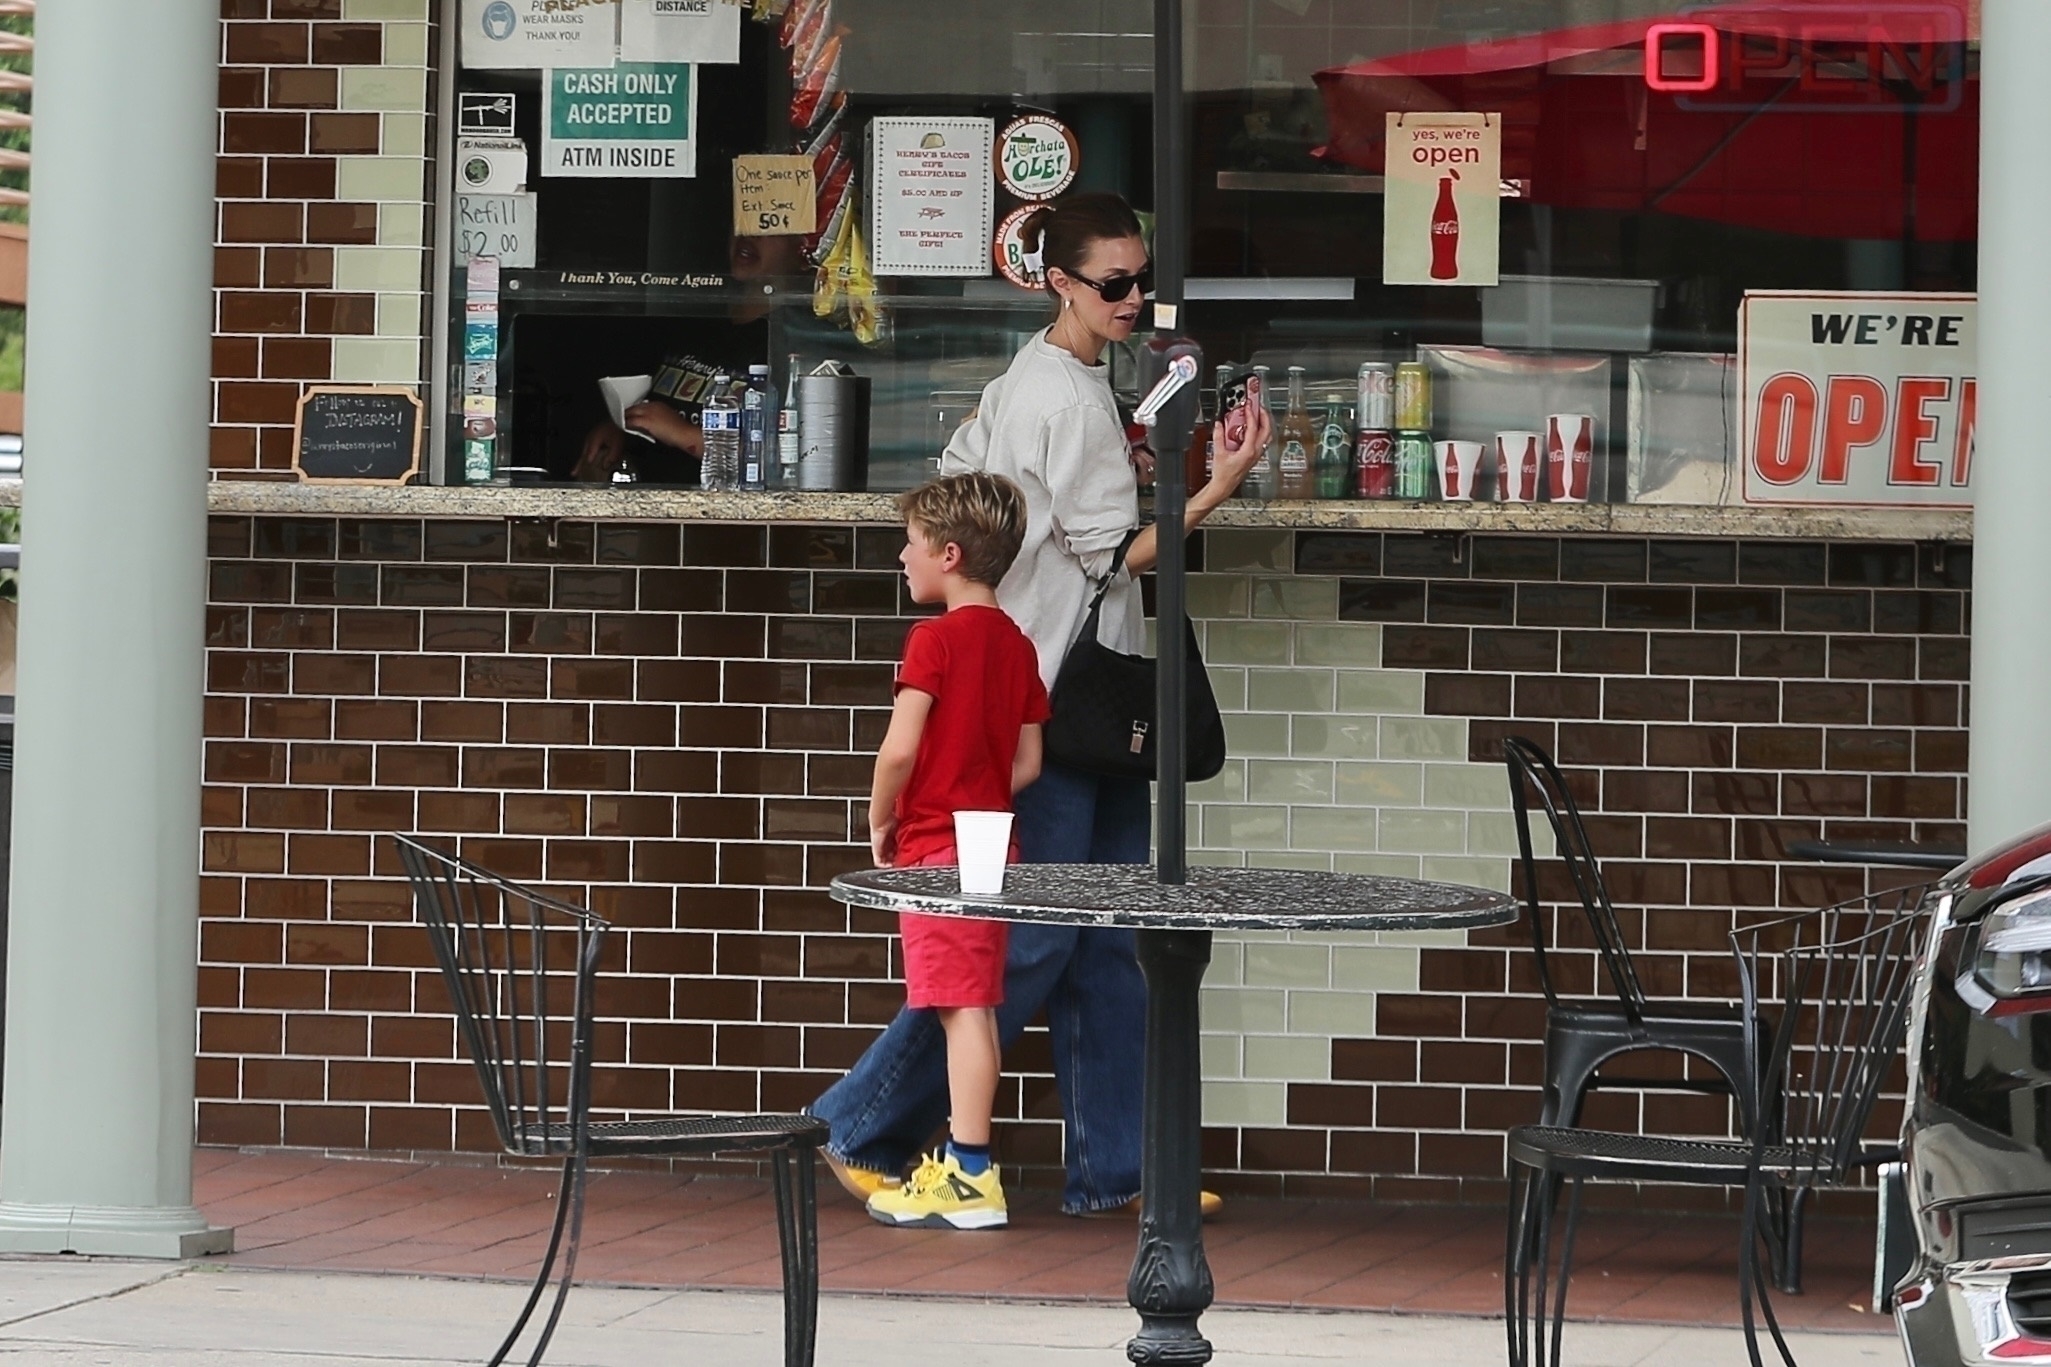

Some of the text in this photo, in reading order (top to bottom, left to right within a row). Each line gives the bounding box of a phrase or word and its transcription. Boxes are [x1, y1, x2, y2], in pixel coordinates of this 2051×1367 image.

[656, 1, 707, 12] DISTANCE
[522, 15, 584, 24] WEAR MASKS
[526, 31, 580, 40] THANK YOU!
[1645, 24, 1936, 101] OPEN
[564, 73, 677, 95] CASH ONLY
[567, 103, 672, 124] ACCEPTED
[1412, 129, 1480, 141] yes, we're
[561, 148, 675, 167] ATM INSIDE
[1412, 147, 1479, 167] open
[736, 165, 762, 182] One
[795, 169, 812, 187] per
[1012, 154, 1064, 182] OLÉ!
[459, 197, 516, 225] Refill
[457, 230, 518, 260] $2.00
[609, 272, 637, 286] You,
[640, 273, 679, 286] Come
[681, 274, 724, 288] Again
[1811, 313, 1964, 346] WE'RE
